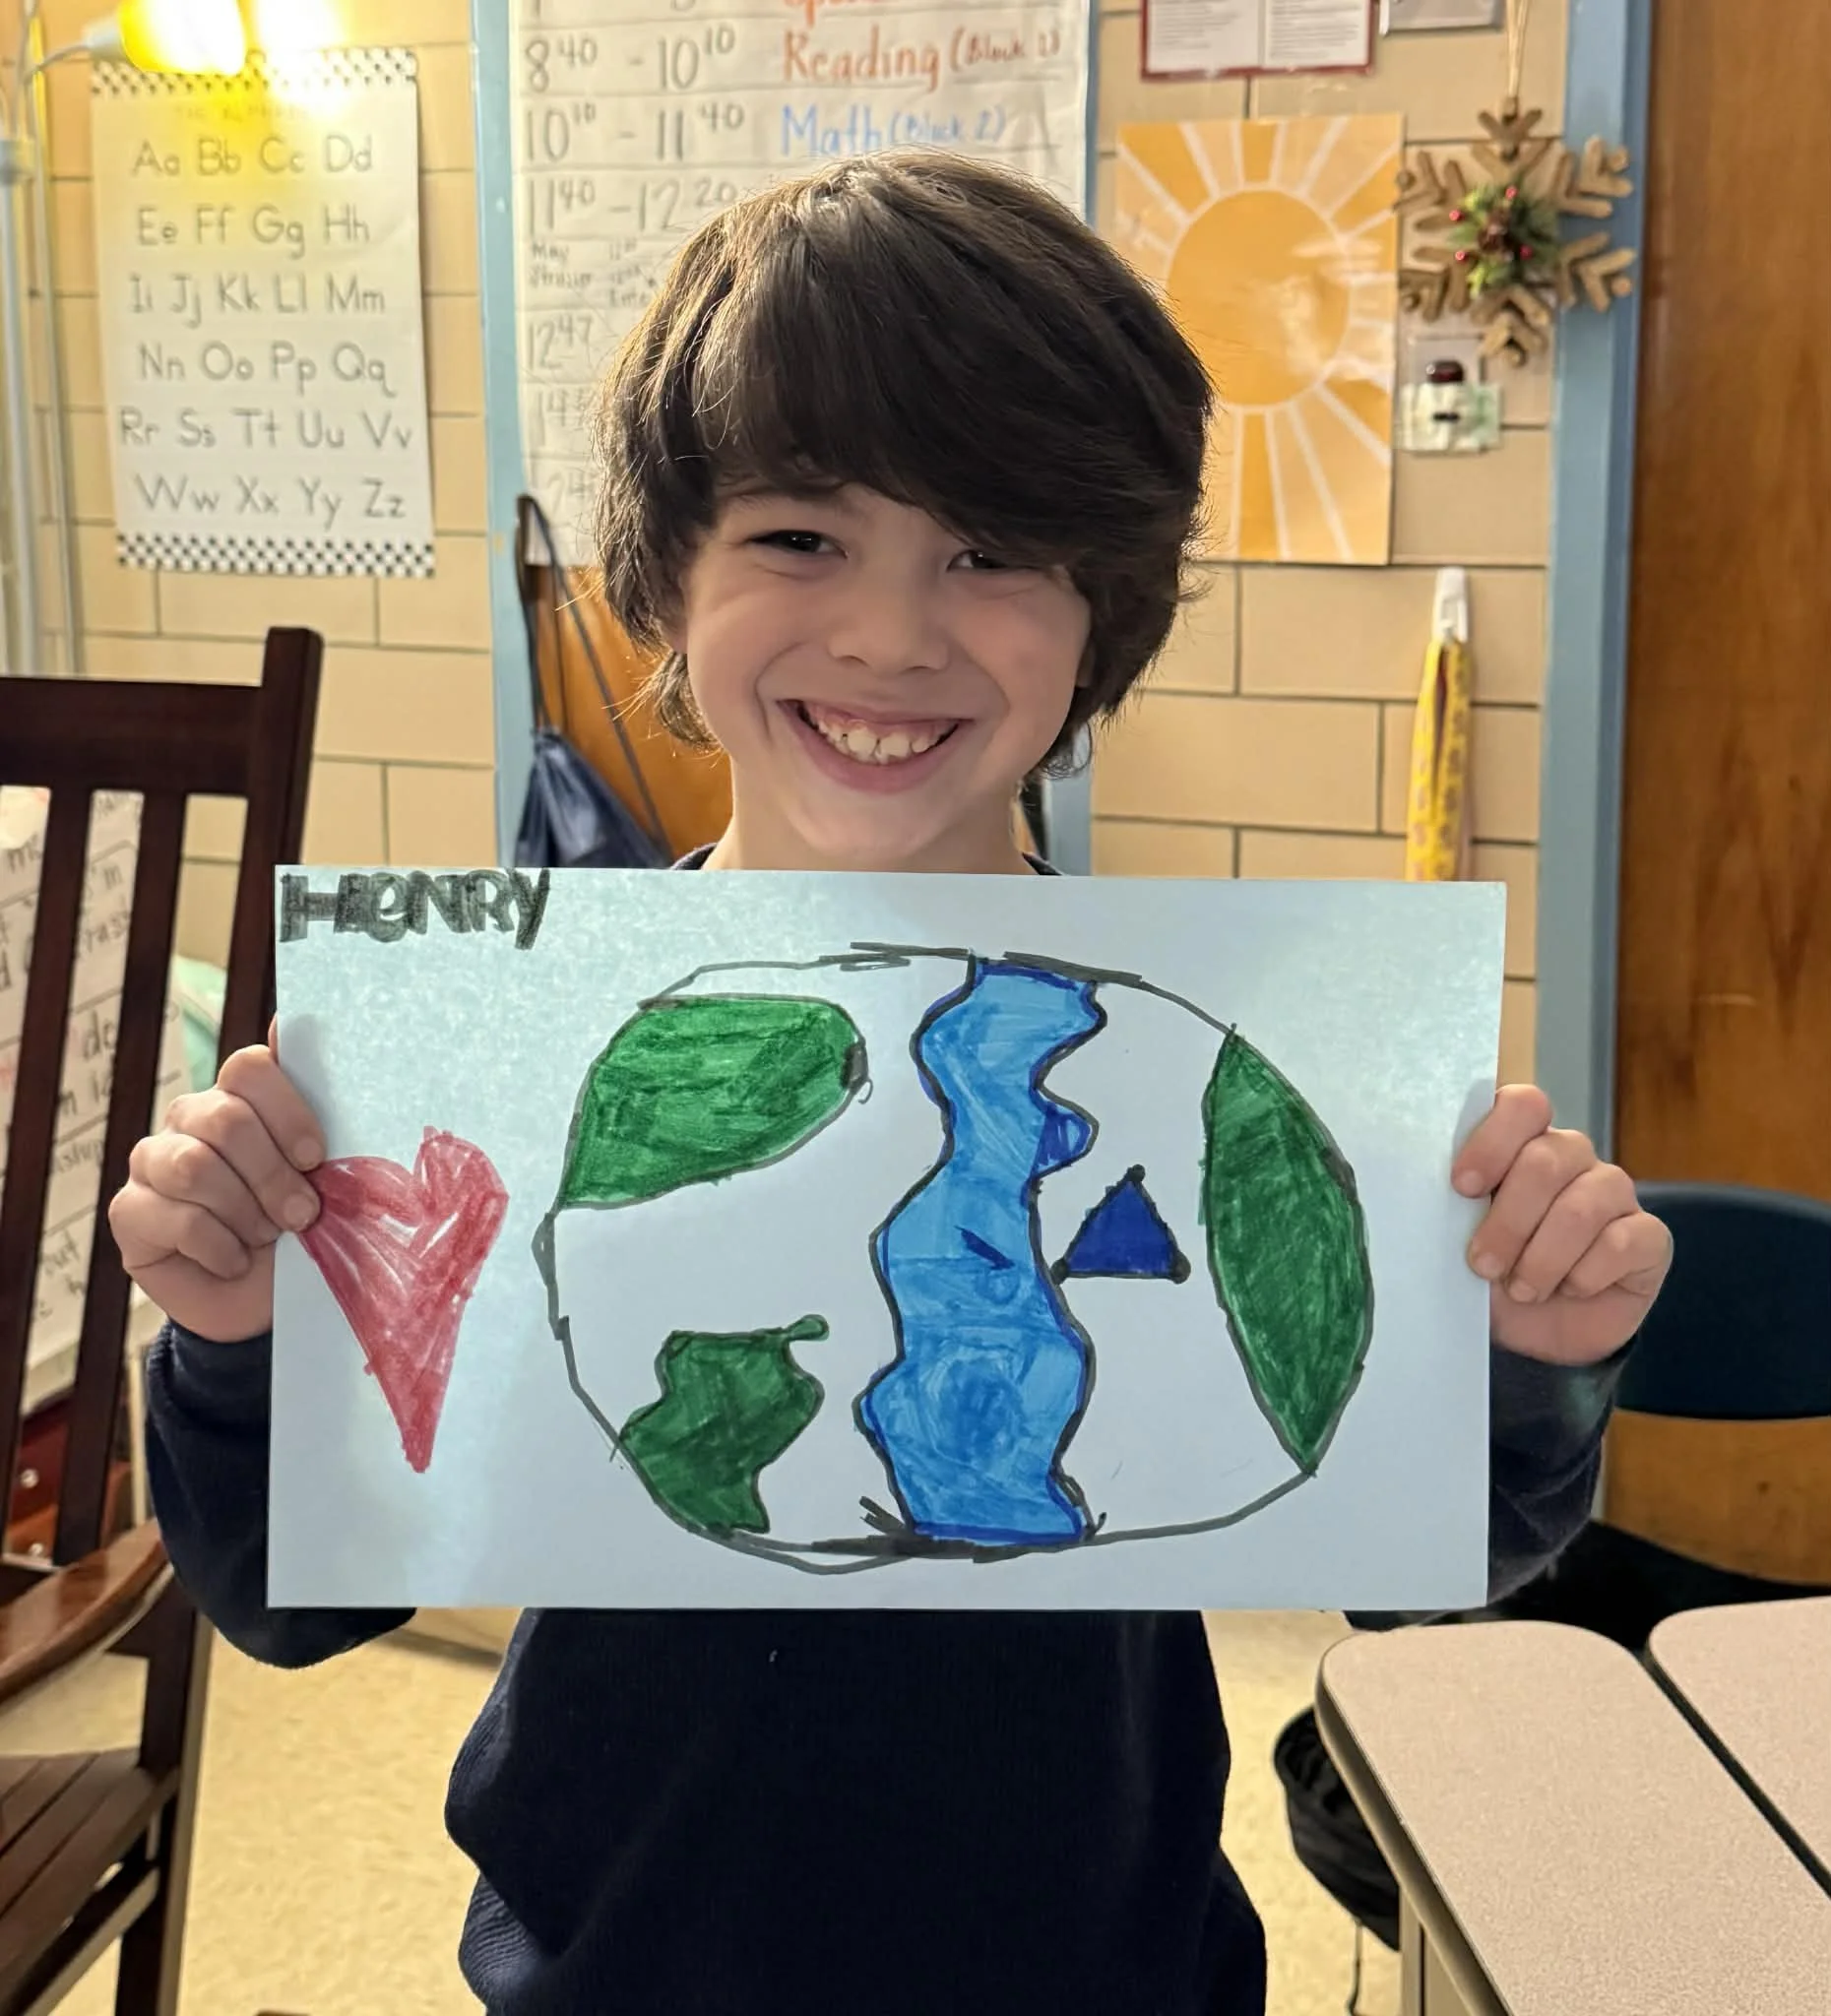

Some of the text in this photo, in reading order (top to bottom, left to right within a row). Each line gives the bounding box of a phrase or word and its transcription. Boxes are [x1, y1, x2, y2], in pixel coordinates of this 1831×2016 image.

[784, 24, 941, 93] Reading
[131, 134, 372, 176] Aa Bb Cc Dd
[782, 104, 882, 157] Math
[138, 204, 369, 260] Ee Ff Gg Hh
[130, 273, 385, 329] Ii Jj Kk Ll Mm
[139, 340, 397, 398] Nn Oo Pp Qq
[120, 405, 411, 449] Rr Ss Tt Uu Vv
[134, 472, 406, 532] Ww Xx Yy Zz
